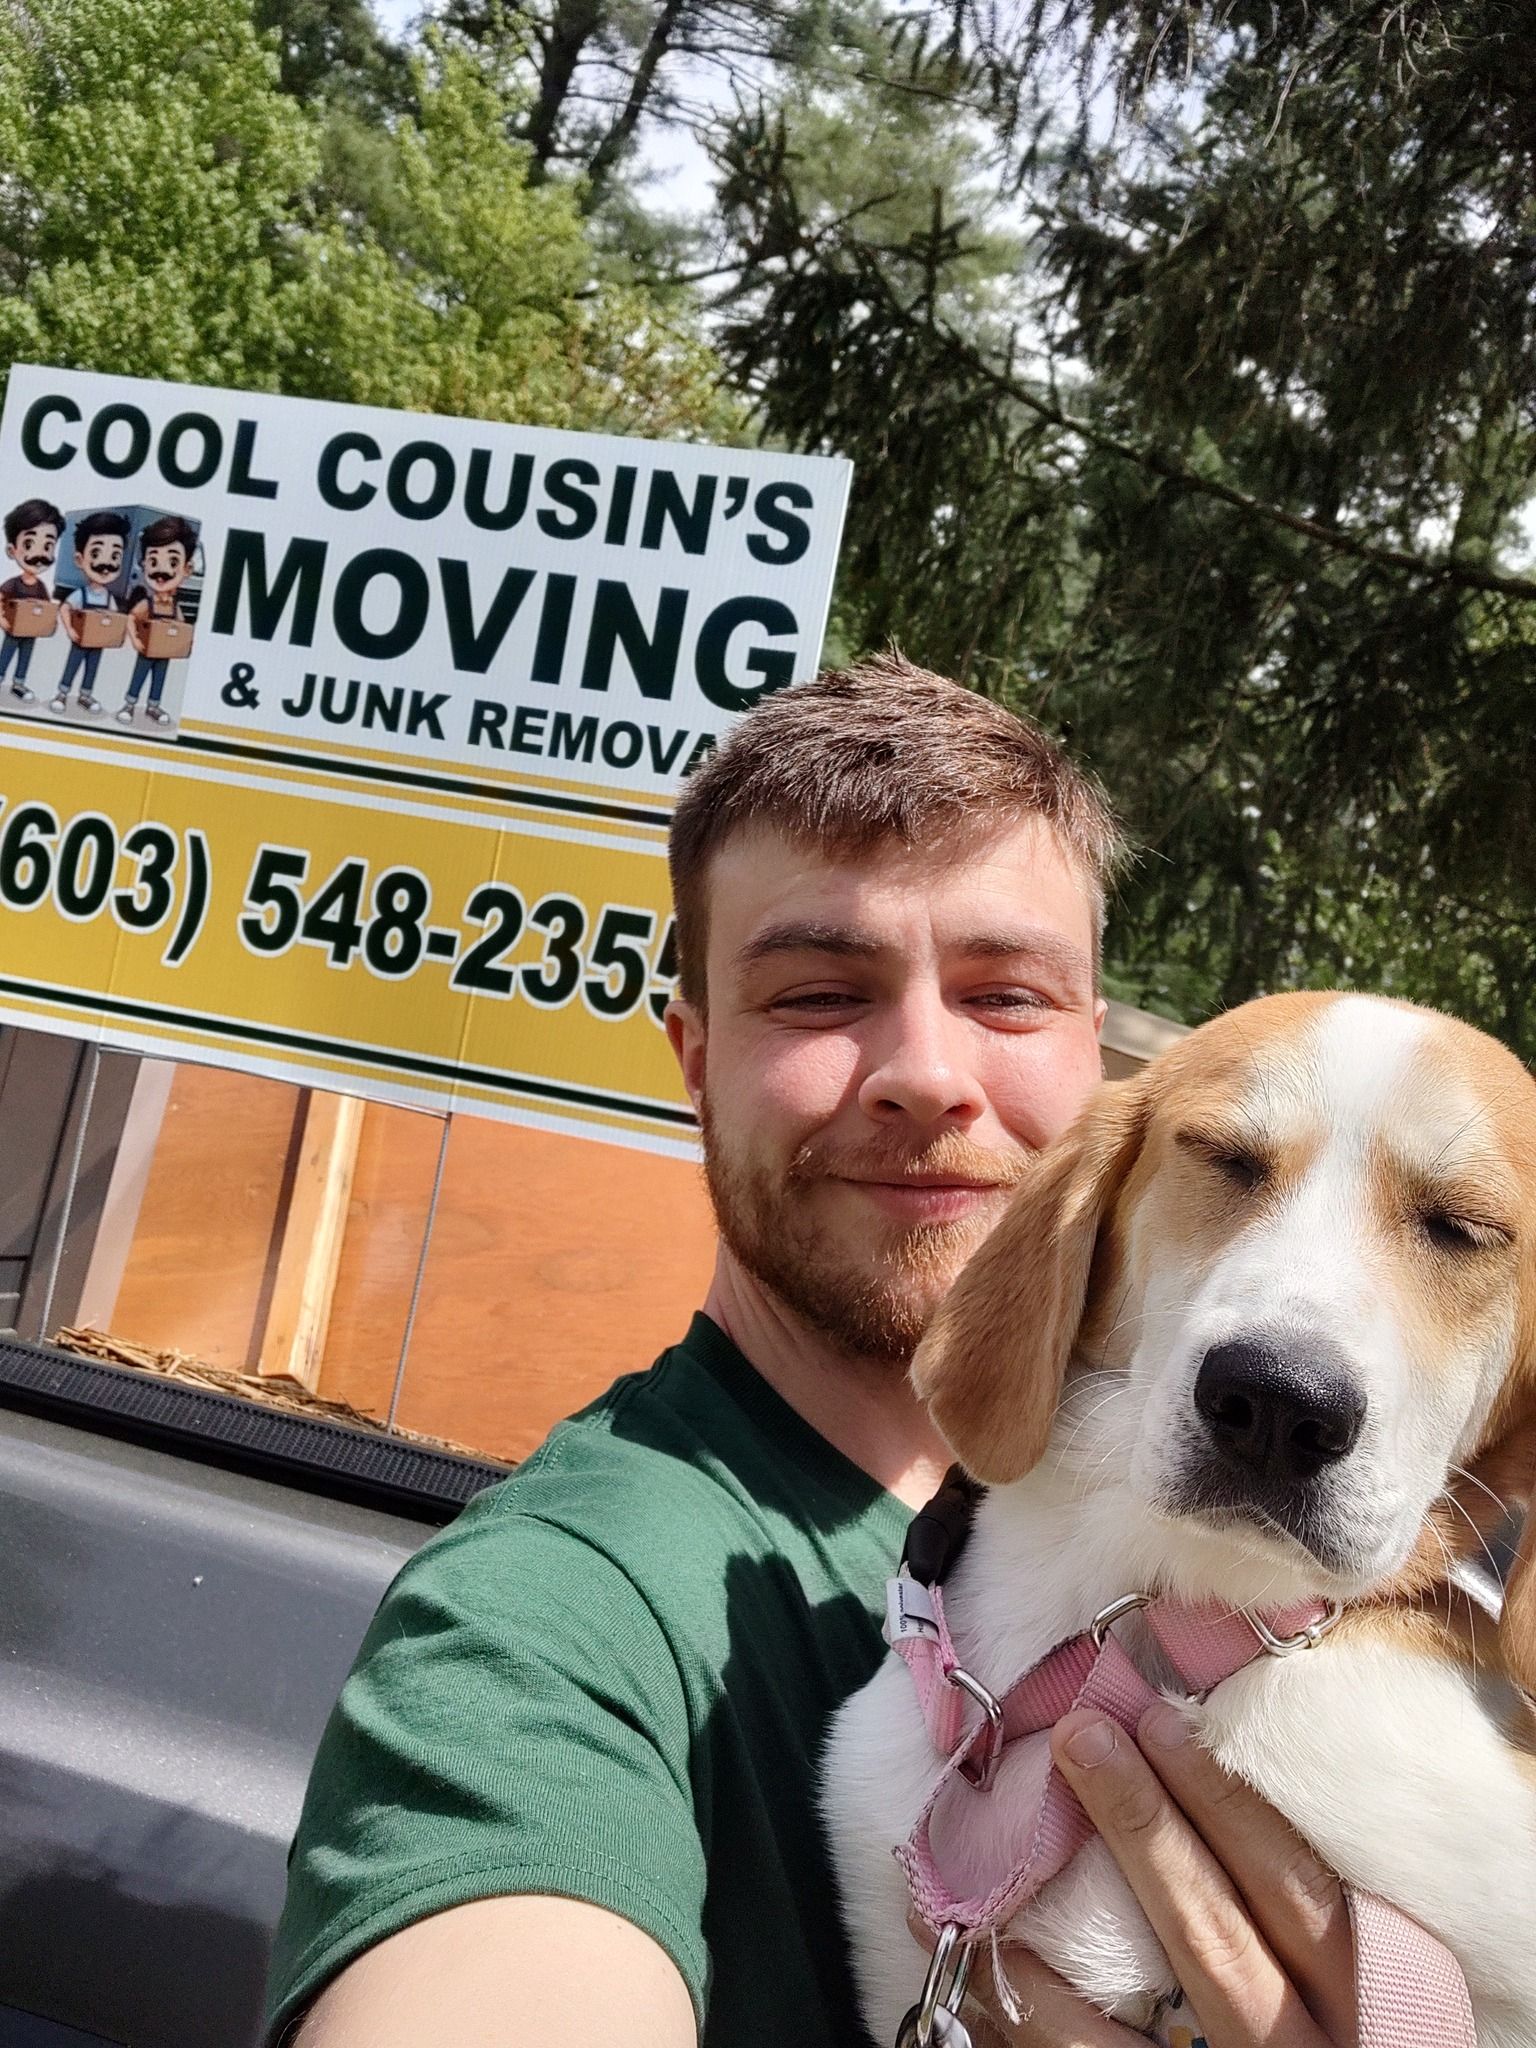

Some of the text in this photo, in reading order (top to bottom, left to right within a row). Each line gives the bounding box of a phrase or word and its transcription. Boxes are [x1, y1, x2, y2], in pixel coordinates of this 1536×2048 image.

[21, 394, 814, 566] COOL COUSIN'S
[211, 527, 799, 713] MOVING
[220, 662, 719, 778] & JUNK REMOVA
[0, 796, 212, 969] 603)
